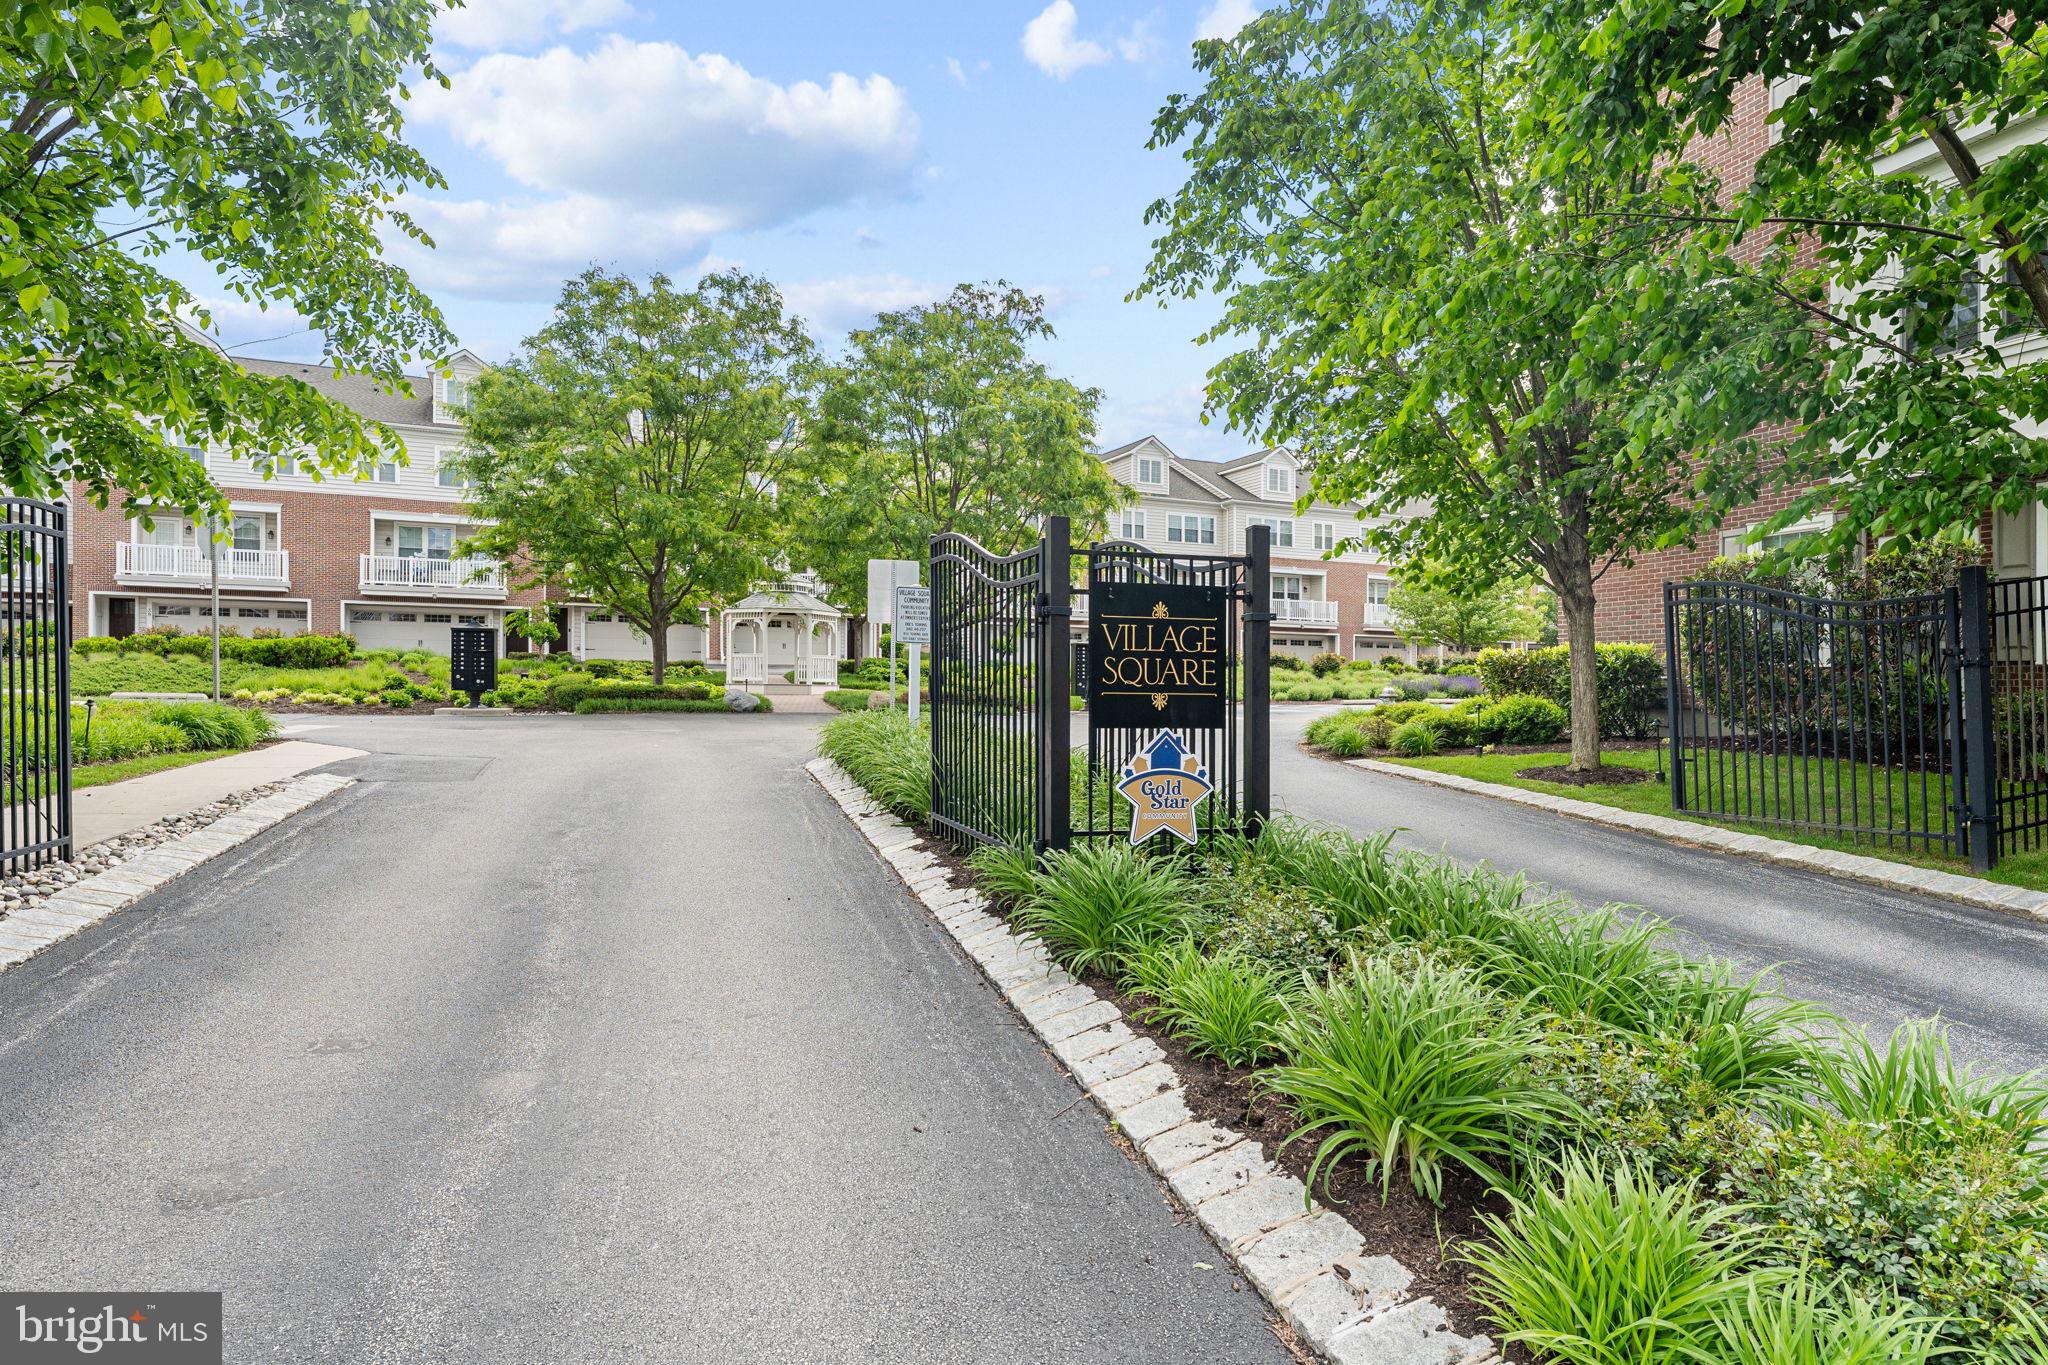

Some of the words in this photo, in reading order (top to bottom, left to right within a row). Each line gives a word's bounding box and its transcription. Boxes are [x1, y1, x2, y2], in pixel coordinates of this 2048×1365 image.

[1101, 623, 1217, 653] VILLAGE
[1102, 656, 1217, 688] SQUARE
[1141, 779, 1182, 796] Gold
[1151, 793, 1190, 810] Star
